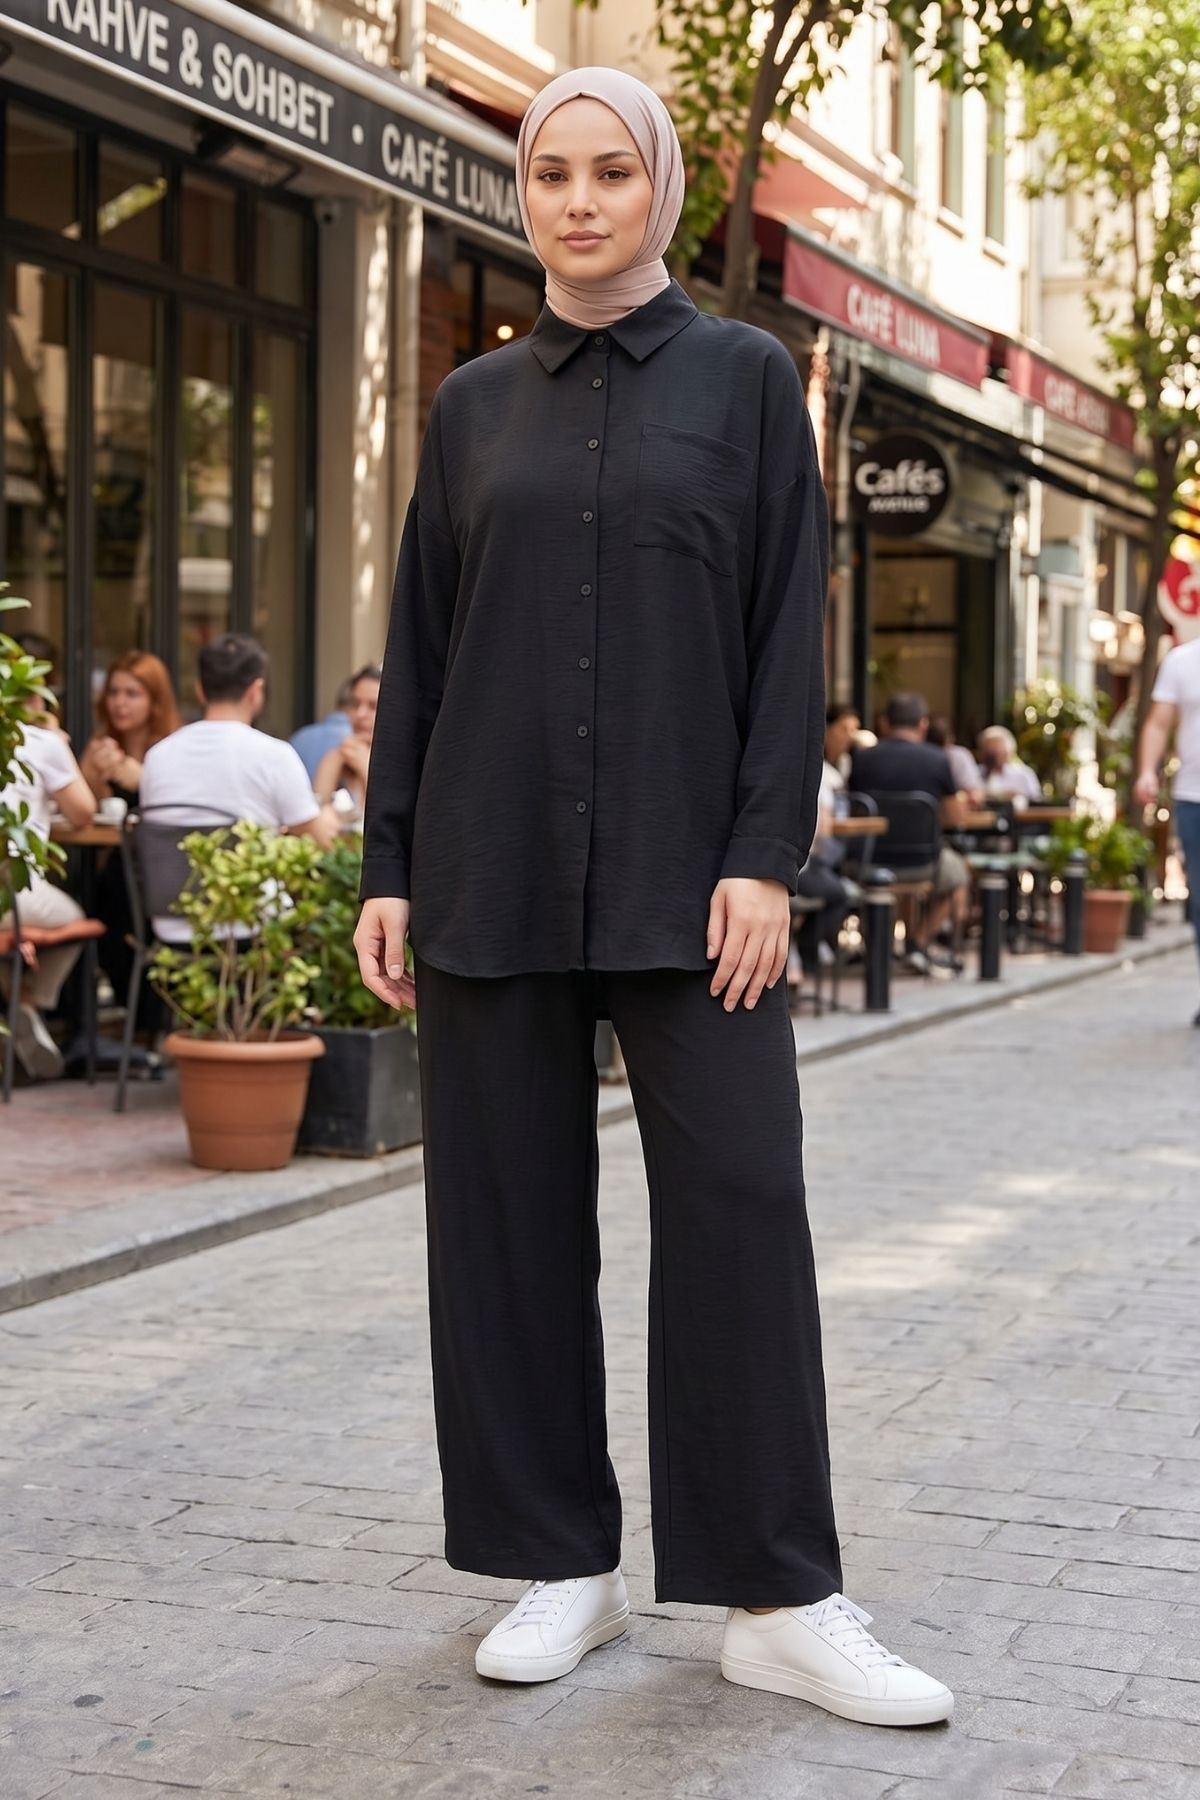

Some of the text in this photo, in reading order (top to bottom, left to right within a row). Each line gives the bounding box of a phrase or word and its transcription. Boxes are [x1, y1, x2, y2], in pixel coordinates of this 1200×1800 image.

[178, 27, 203, 88] &
[211, 42, 334, 145] SOHBET
[381, 122, 450, 199] CAFÉ
[455, 157, 521, 231] LUNA
[855, 459, 945, 496] Cafés
